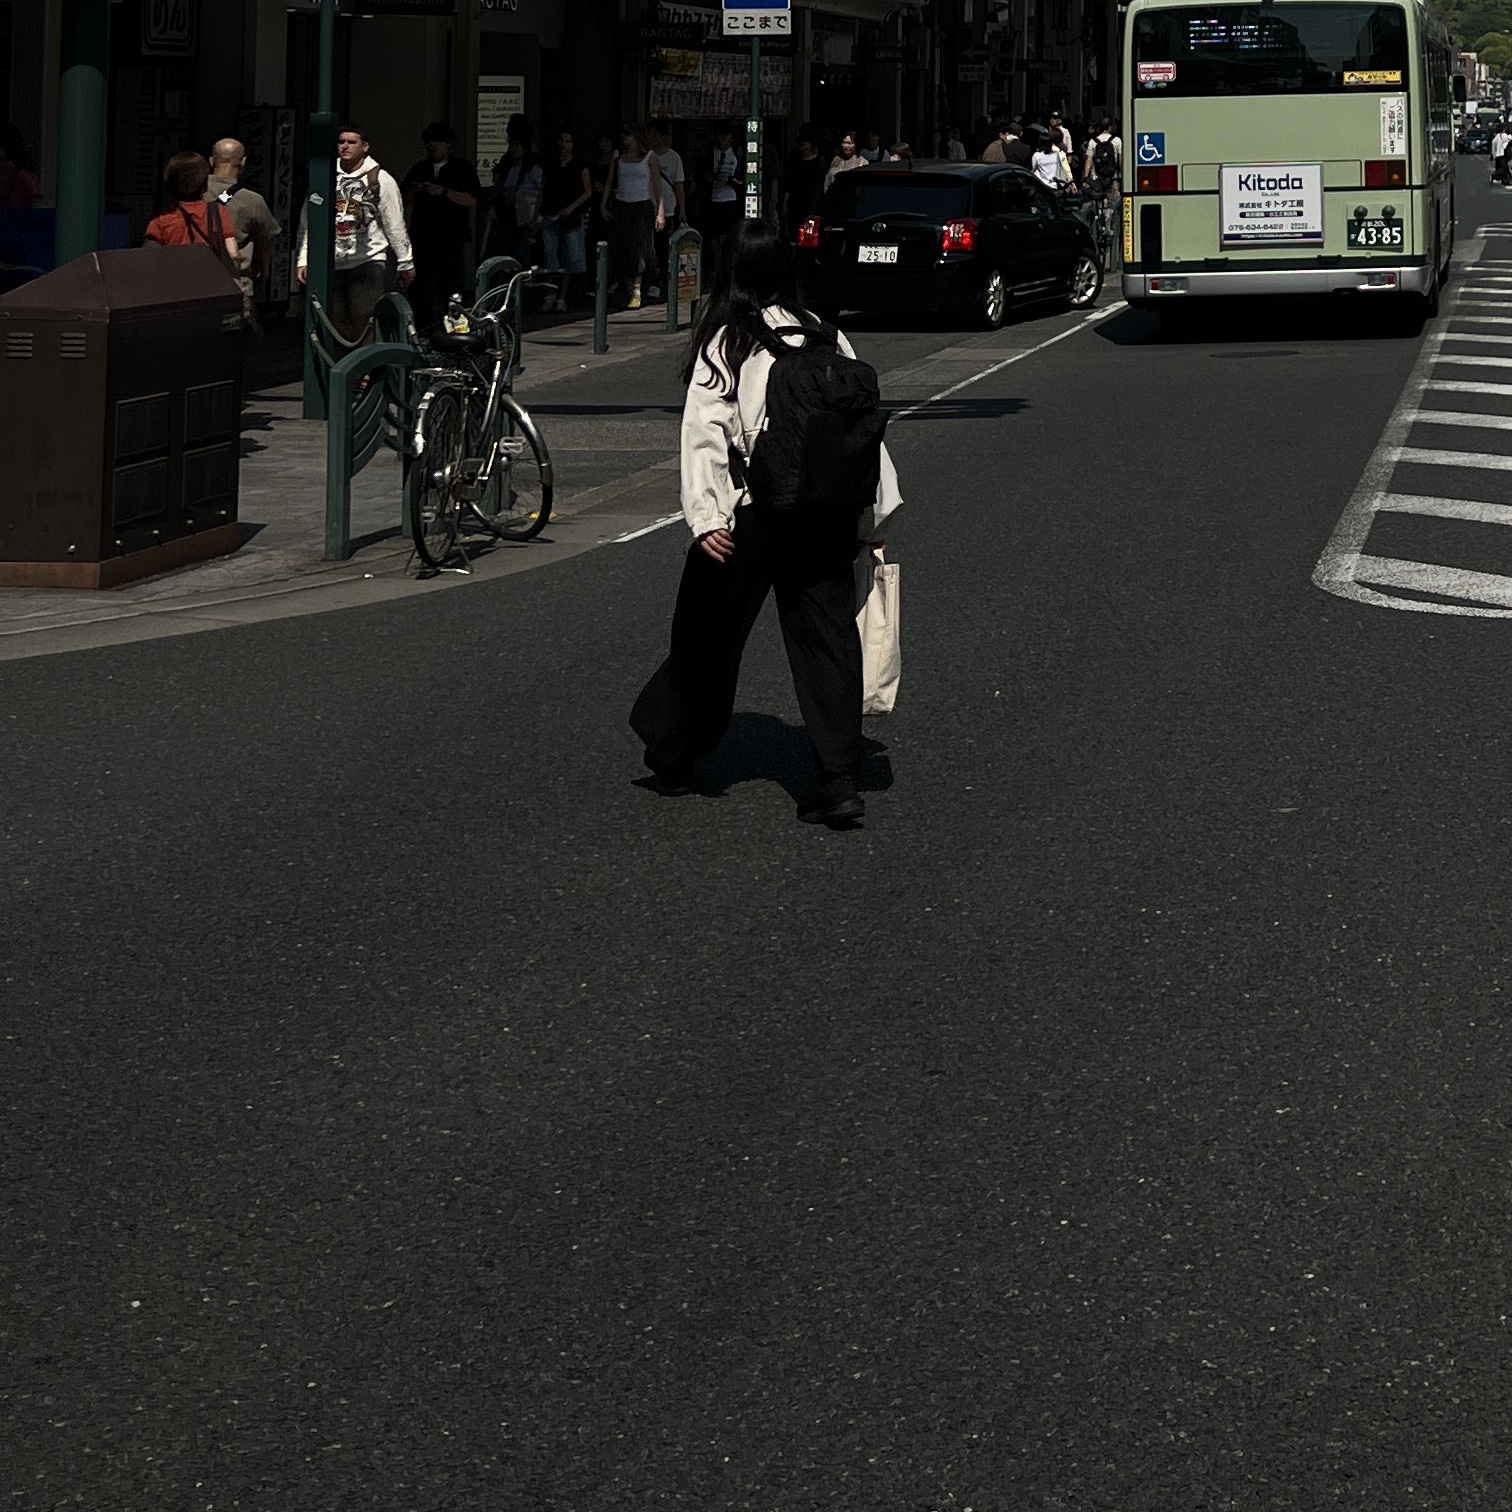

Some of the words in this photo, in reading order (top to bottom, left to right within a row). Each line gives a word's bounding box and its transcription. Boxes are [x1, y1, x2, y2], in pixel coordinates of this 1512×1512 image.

[727, 15, 788, 30] ここまで
[640, 26, 692, 39] RAGTAG
[1238, 173, 1304, 191] Kitoda
